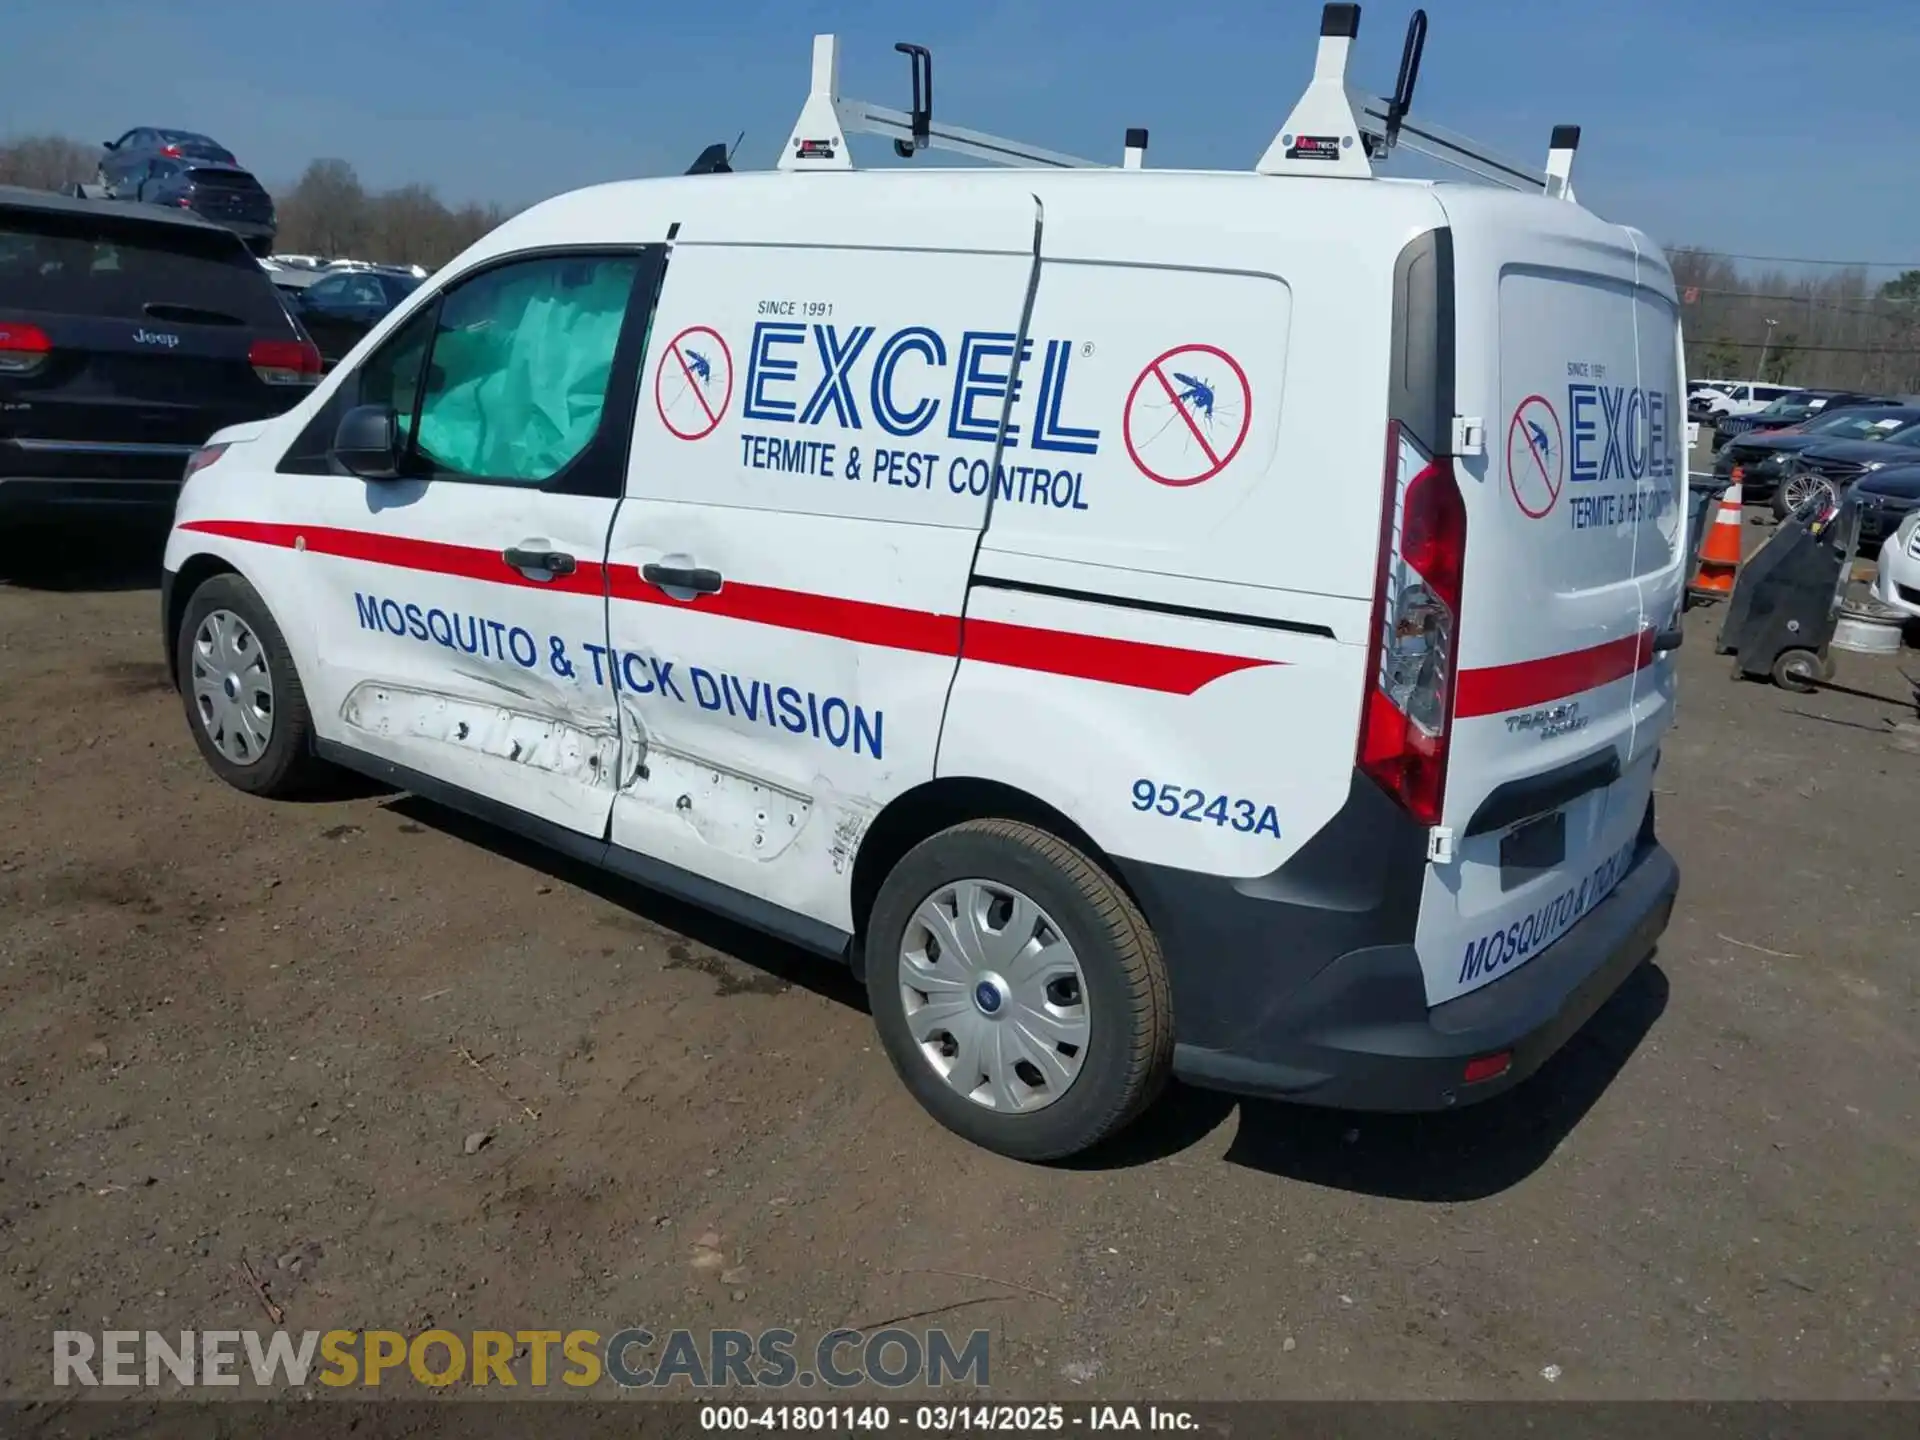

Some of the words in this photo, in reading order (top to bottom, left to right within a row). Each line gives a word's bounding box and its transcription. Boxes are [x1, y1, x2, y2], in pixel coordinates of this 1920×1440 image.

[133, 328, 179, 348] Jeep
[757, 300, 796, 316] SINCE
[802, 302, 834, 316] 1991
[743, 322, 1100, 455] EXCEL
[1568, 384, 1674, 482] EXCEL
[741, 435, 836, 474] TERMITE
[846, 450, 862, 481] &
[873, 449, 940, 489] PEST
[948, 457, 1089, 511] CONTROL
[1569, 495, 1615, 529] TERMITE
[355, 592, 538, 668] MOSQUITO
[550, 636, 575, 677] &
[583, 643, 686, 702] TICK
[690, 667, 885, 760] DIVISION
[1132, 778, 1281, 839] 95243A
[1459, 886, 1575, 985] MOSQUITO
